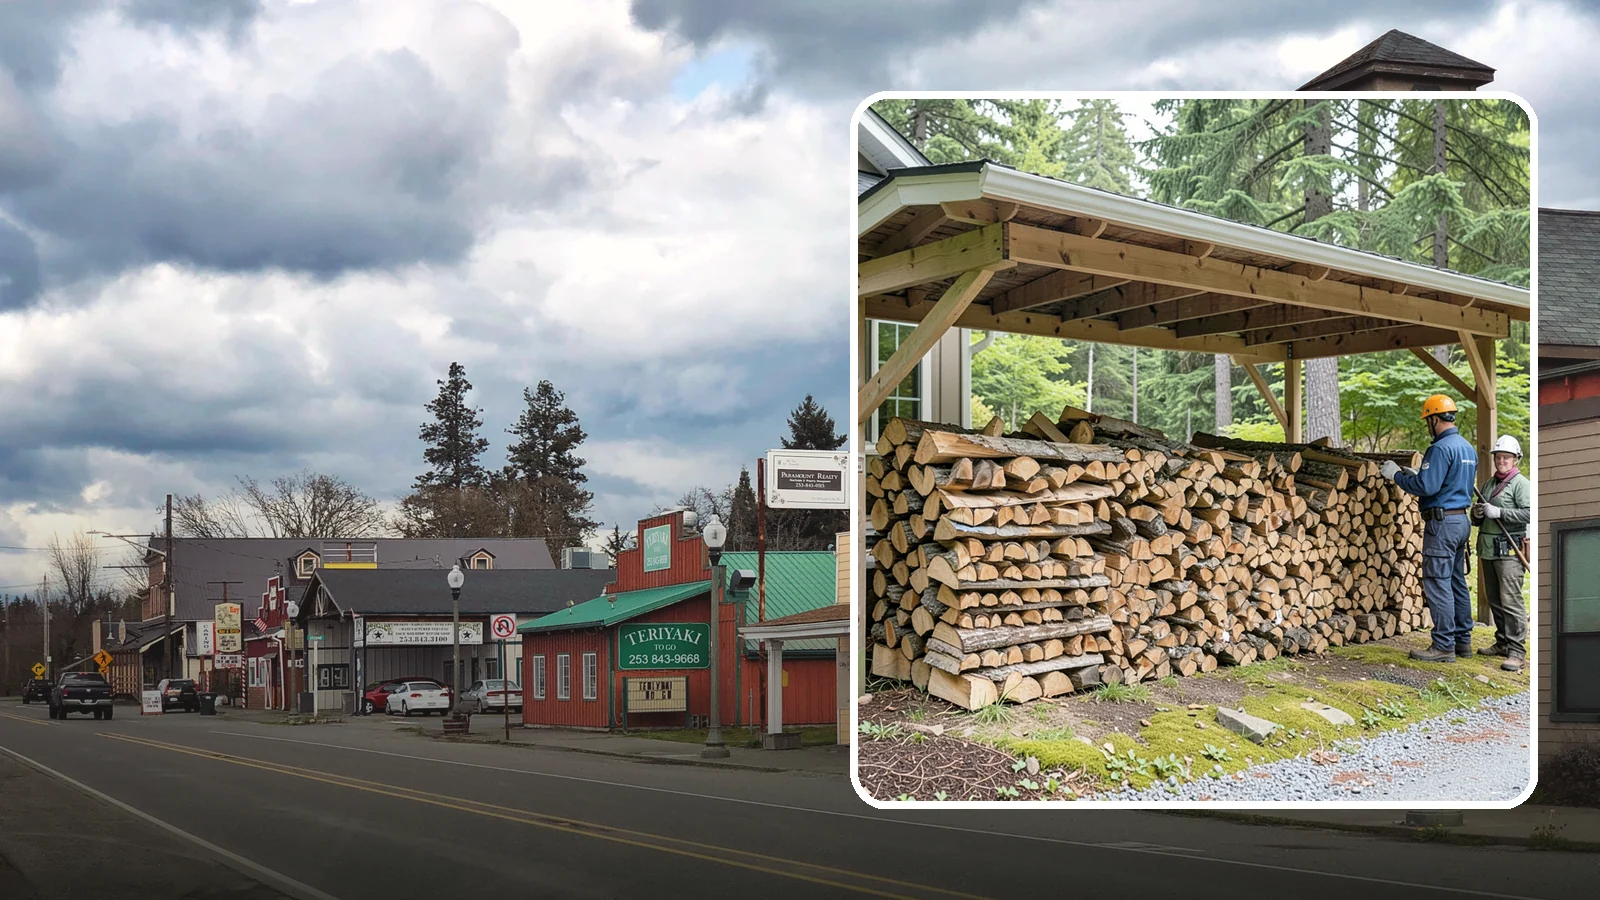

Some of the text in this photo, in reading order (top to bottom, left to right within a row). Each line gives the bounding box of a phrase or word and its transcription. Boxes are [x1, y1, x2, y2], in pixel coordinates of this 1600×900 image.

[646, 531, 668, 549] TERIYAKI
[625, 627, 702, 646] TERIYAKI
[629, 654, 700, 664] 253 843-9668
[639, 682, 672, 690] TERIYAKI
